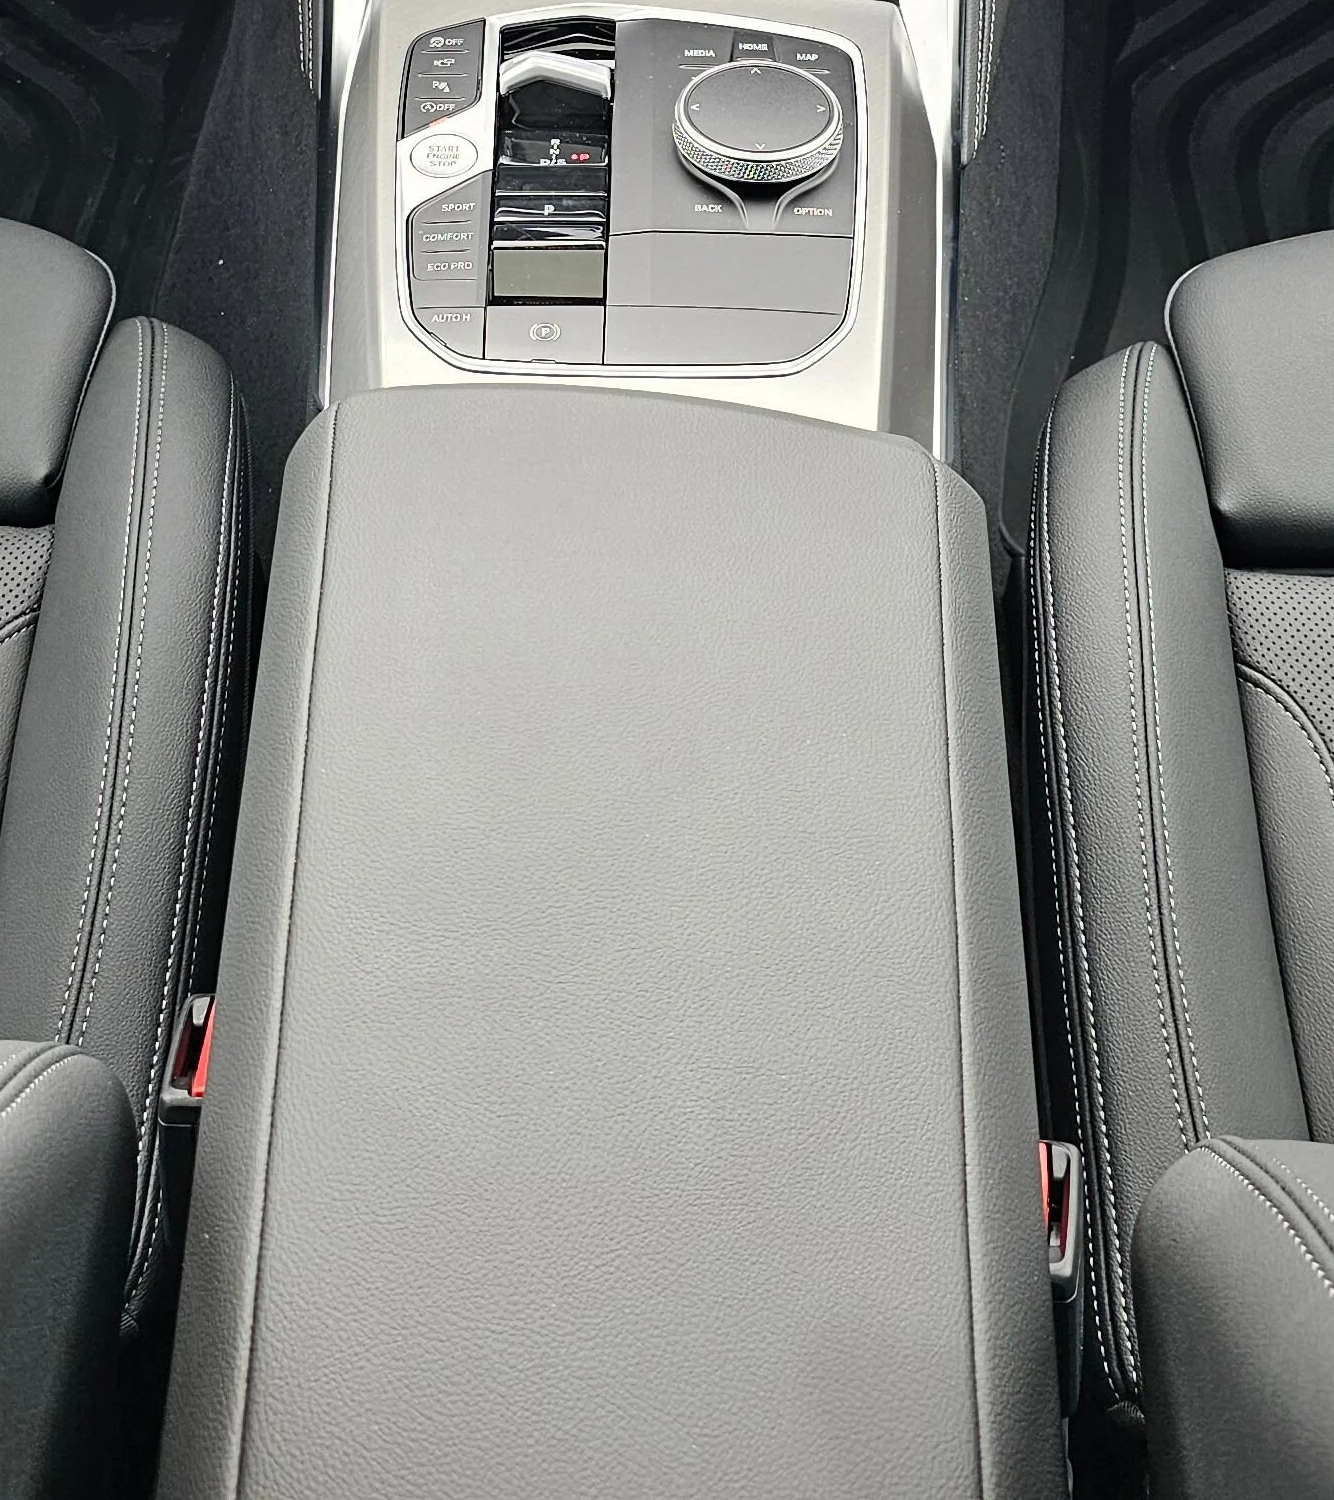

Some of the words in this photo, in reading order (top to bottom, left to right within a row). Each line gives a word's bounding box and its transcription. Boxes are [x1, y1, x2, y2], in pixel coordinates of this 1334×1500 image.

[445, 37, 465, 46] OFF
[738, 42, 769, 51] HOME
[684, 49, 716, 58] MEDIA
[796, 53, 819, 61] MAP
[436, 103, 456, 112] OFF
[428, 145, 460, 153] START
[429, 160, 457, 168] STOP
[441, 202, 476, 212] SPORT
[694, 204, 723, 213] BACK
[793, 206, 833, 217] OPTION
[422, 232, 475, 242] COMFORT
[450, 261, 474, 271] PRO
[431, 313, 462, 323] AUTO
[462, 313, 472, 322] H
